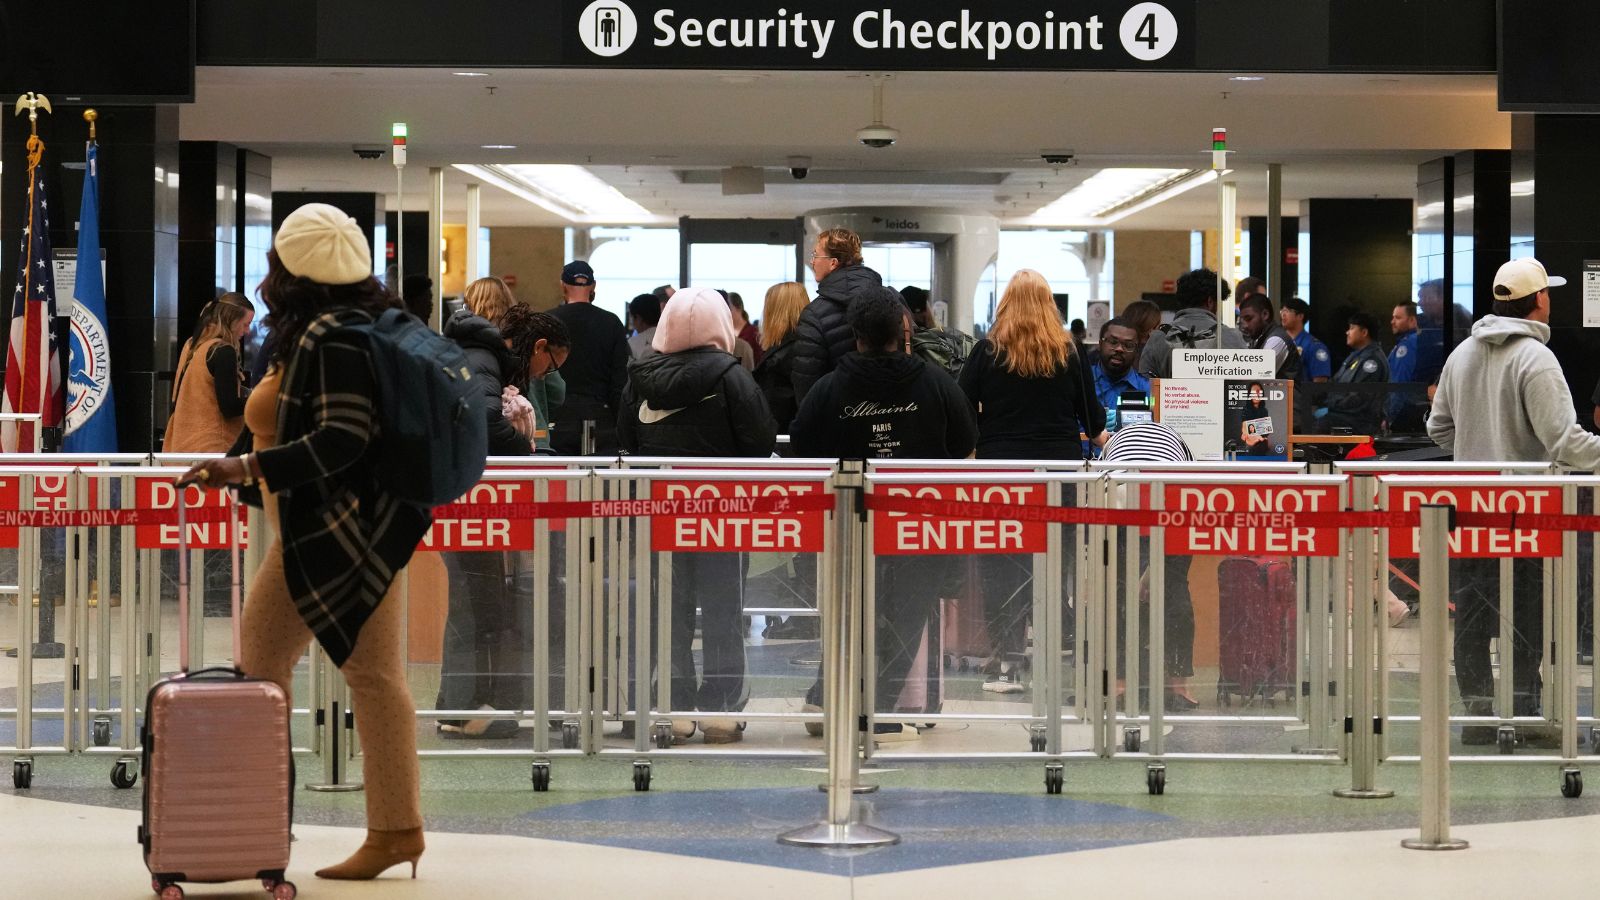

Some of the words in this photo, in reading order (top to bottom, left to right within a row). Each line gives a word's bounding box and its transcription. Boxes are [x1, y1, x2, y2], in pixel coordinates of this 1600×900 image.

[653, 8, 836, 59] Security
[852, 9, 1104, 60] Checkpoint
[1134, 13, 1159, 50] 4
[885, 218, 920, 230] leidos
[71, 304, 106, 396] DEPARTMENT
[1184, 352, 1230, 364] Employee
[1232, 352, 1264, 363] Access
[1198, 366, 1253, 376] Verification
[1228, 390, 1268, 400] REAL
[1269, 390, 1285, 401] ID
[81, 396, 96, 416] OF
[839, 401, 919, 419] Allsaints
[872, 423, 892, 433] PARIS
[592, 499, 679, 517] EMERGENCY
[684, 499, 715, 514] EXIT
[719, 498, 756, 513] ONLY
[735, 485, 812, 514] NOT
[888, 487, 942, 517] DO
[1180, 488, 1235, 512] DO
[1249, 489, 1327, 512] NOT
[1471, 490, 1549, 514] NOT
[42, 510, 77, 526] EXIT
[81, 510, 121, 525] ONLY
[1158, 511, 1185, 526] DO
[1190, 512, 1227, 527] NOT
[1234, 512, 1296, 528] ENTER
[675, 518, 803, 548] ENTER
[897, 520, 1025, 550] ENTER
[1412, 527, 1539, 553] NTER
